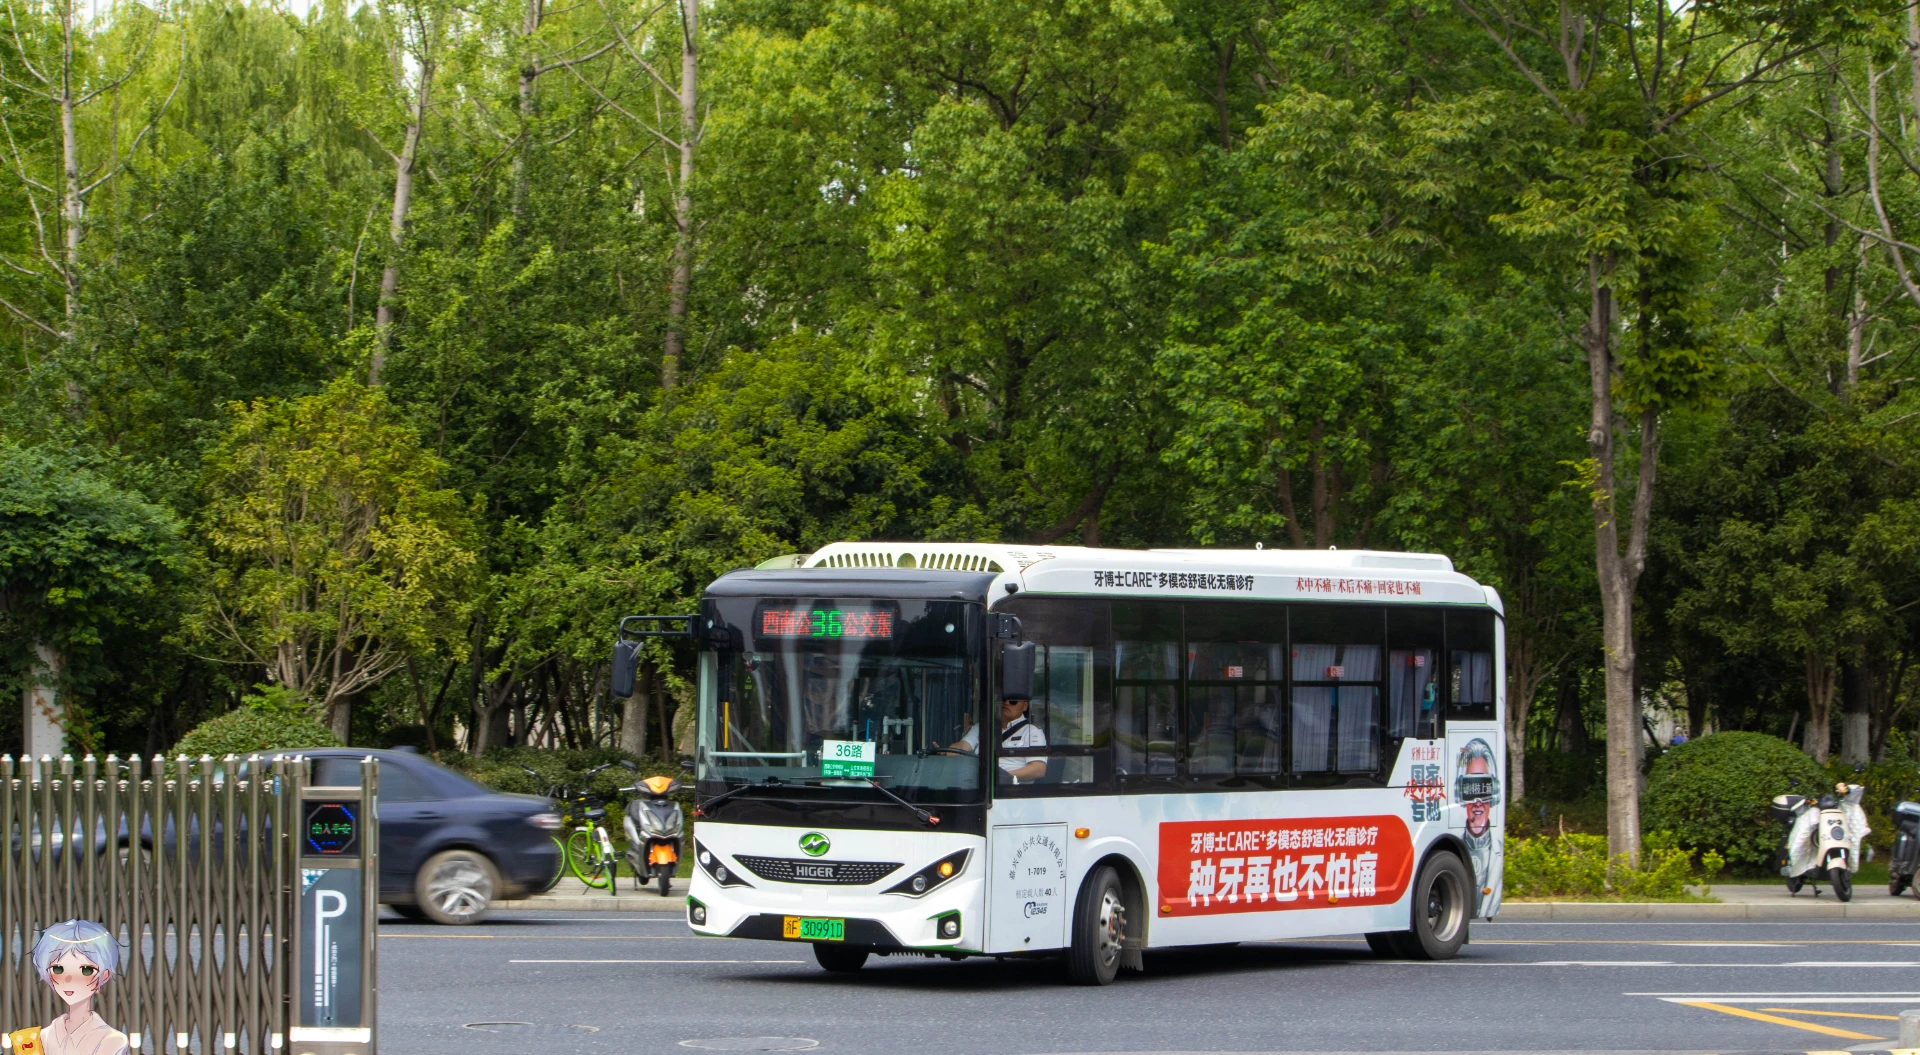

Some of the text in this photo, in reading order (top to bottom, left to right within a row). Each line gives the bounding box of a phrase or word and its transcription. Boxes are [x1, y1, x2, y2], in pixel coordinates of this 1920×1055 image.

[835, 744, 863, 758] 36路
[795, 864, 834, 879] HIGER
[1028, 867, 1047, 876] 1-7019
[1187, 852, 1379, 907] 种牙再也不怕痛
[1030, 906, 1048, 916] 12345
